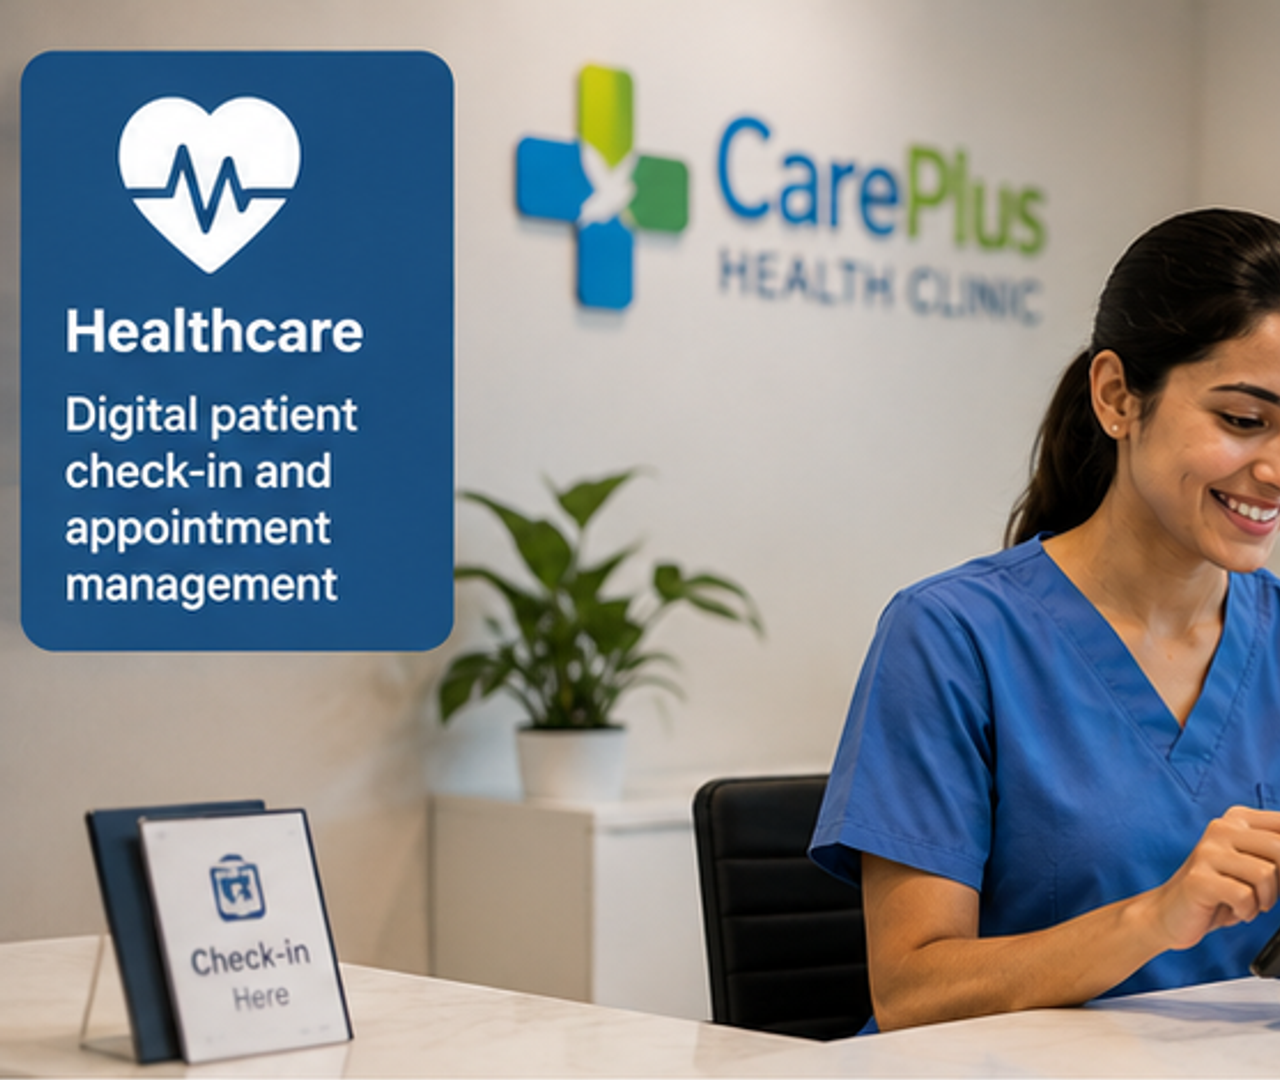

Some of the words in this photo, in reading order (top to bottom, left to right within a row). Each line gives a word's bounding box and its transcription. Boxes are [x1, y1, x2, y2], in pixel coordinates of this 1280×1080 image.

[718, 115, 1046, 254] CarePlus
[719, 249, 896, 307] HEALTH
[907, 265, 1045, 327] CLINIC
[191, 938, 311, 977] Check-in
[232, 986, 290, 1011] Here
